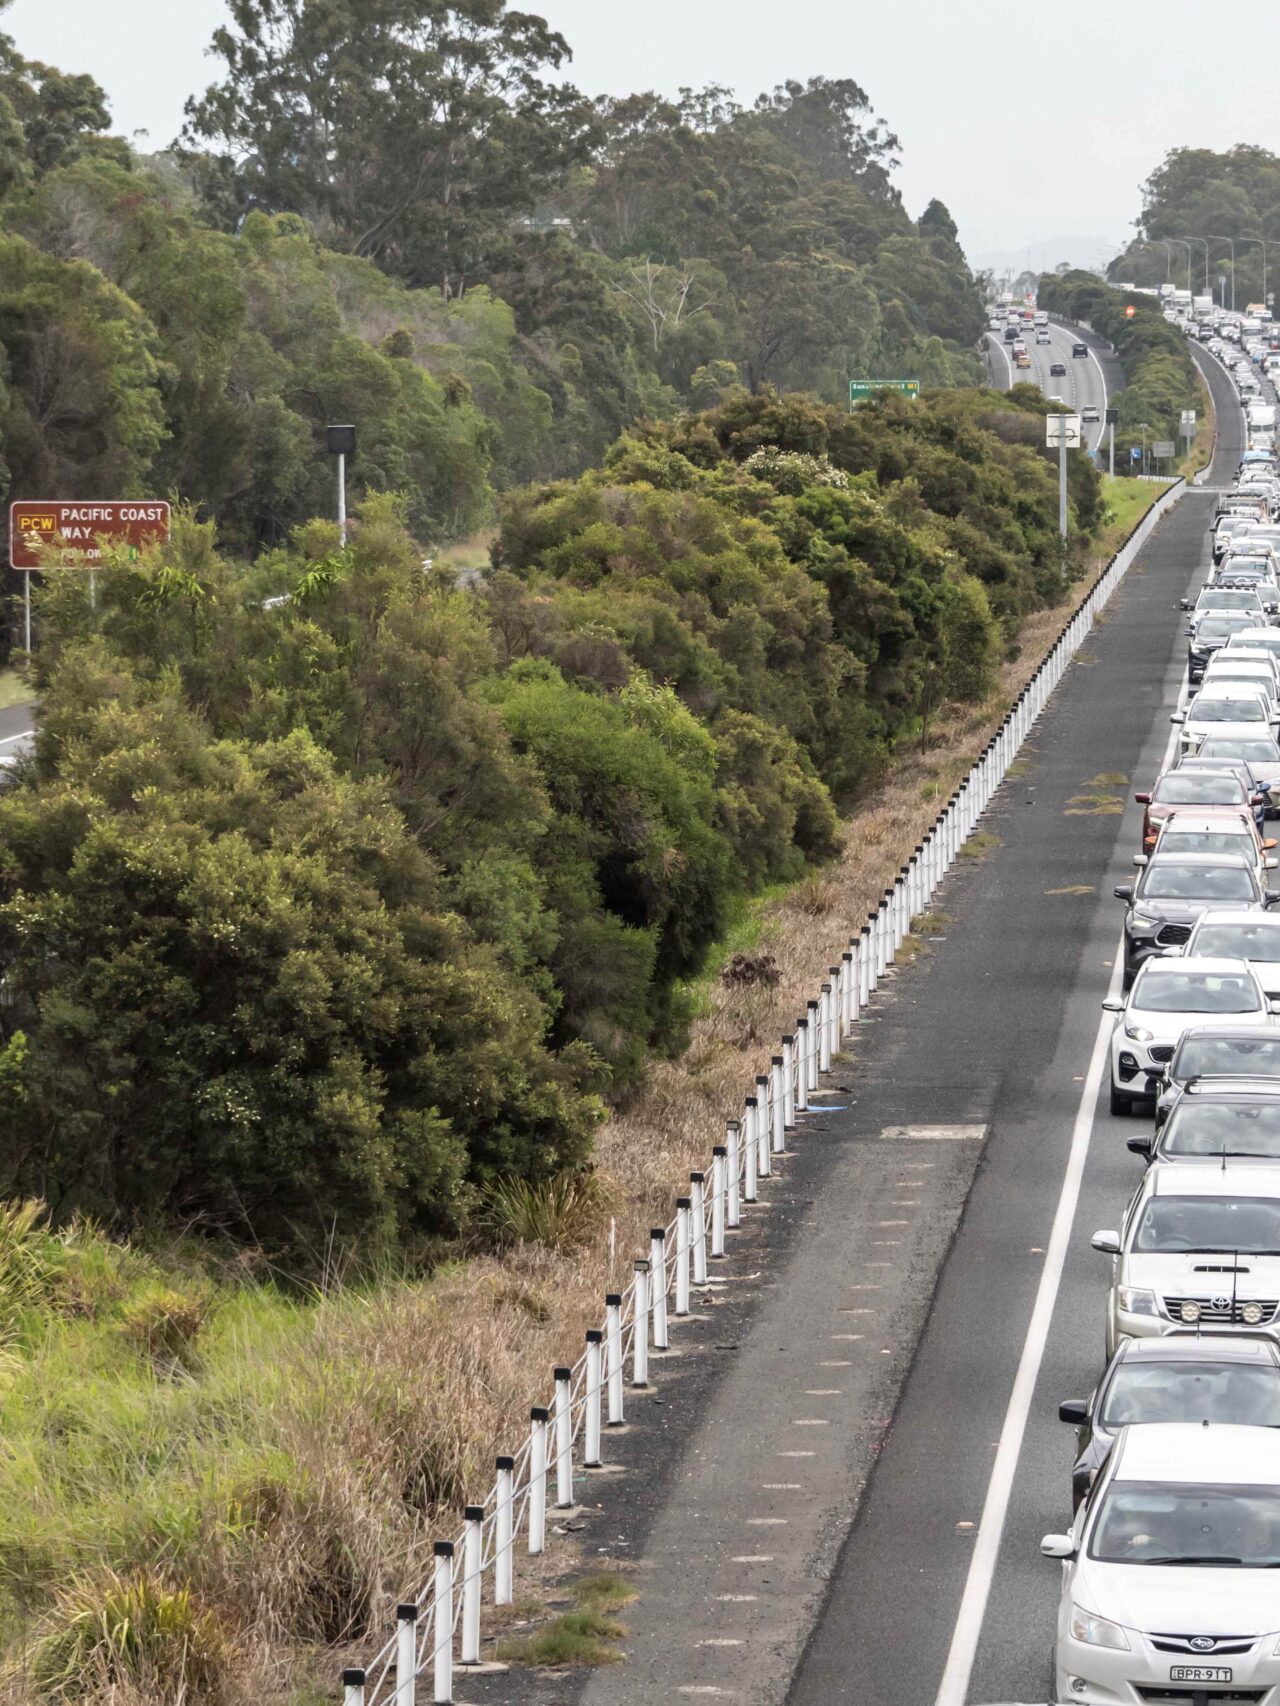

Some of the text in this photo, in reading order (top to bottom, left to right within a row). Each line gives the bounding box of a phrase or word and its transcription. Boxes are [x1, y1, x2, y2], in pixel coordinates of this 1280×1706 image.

[61, 508, 163, 521] PACIFIC COAST
[20, 517, 53, 530] PCW
[61, 526, 92, 539] WAY
[61, 548, 101, 560] FOOW
